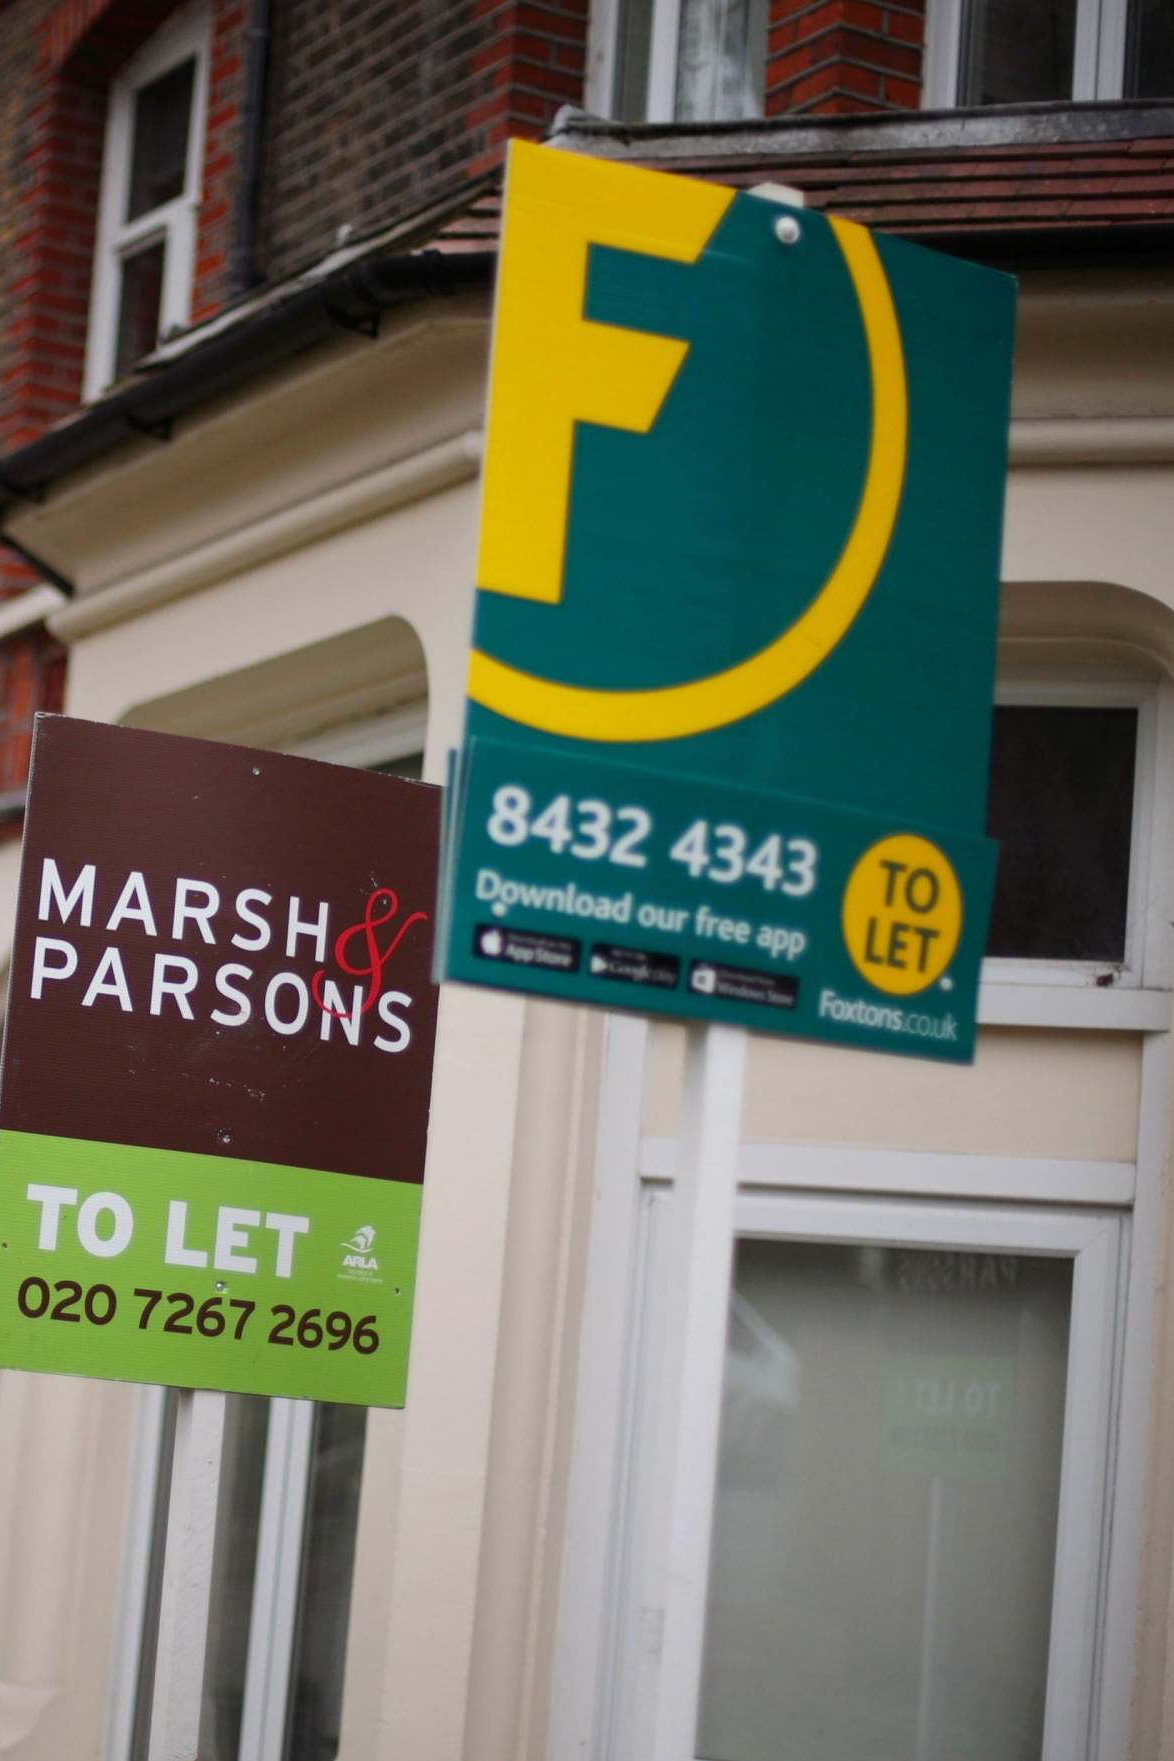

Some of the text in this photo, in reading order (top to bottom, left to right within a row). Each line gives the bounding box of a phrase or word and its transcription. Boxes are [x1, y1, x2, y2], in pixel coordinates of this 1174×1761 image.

[487, 786, 818, 896] 8432 4343
[476, 869, 806, 958] Download our free app
[879, 859, 940, 915] TO
[37, 857, 427, 1019] MARSH &
[505, 943, 573, 967] App Store
[864, 916, 941, 974] LET
[30, 936, 413, 1053] PARSONS
[819, 988, 959, 1040] Foxtons.co.uk
[26, 1183, 310, 1279] TO LET
[17, 1276, 380, 1354] 020 7267 2696
